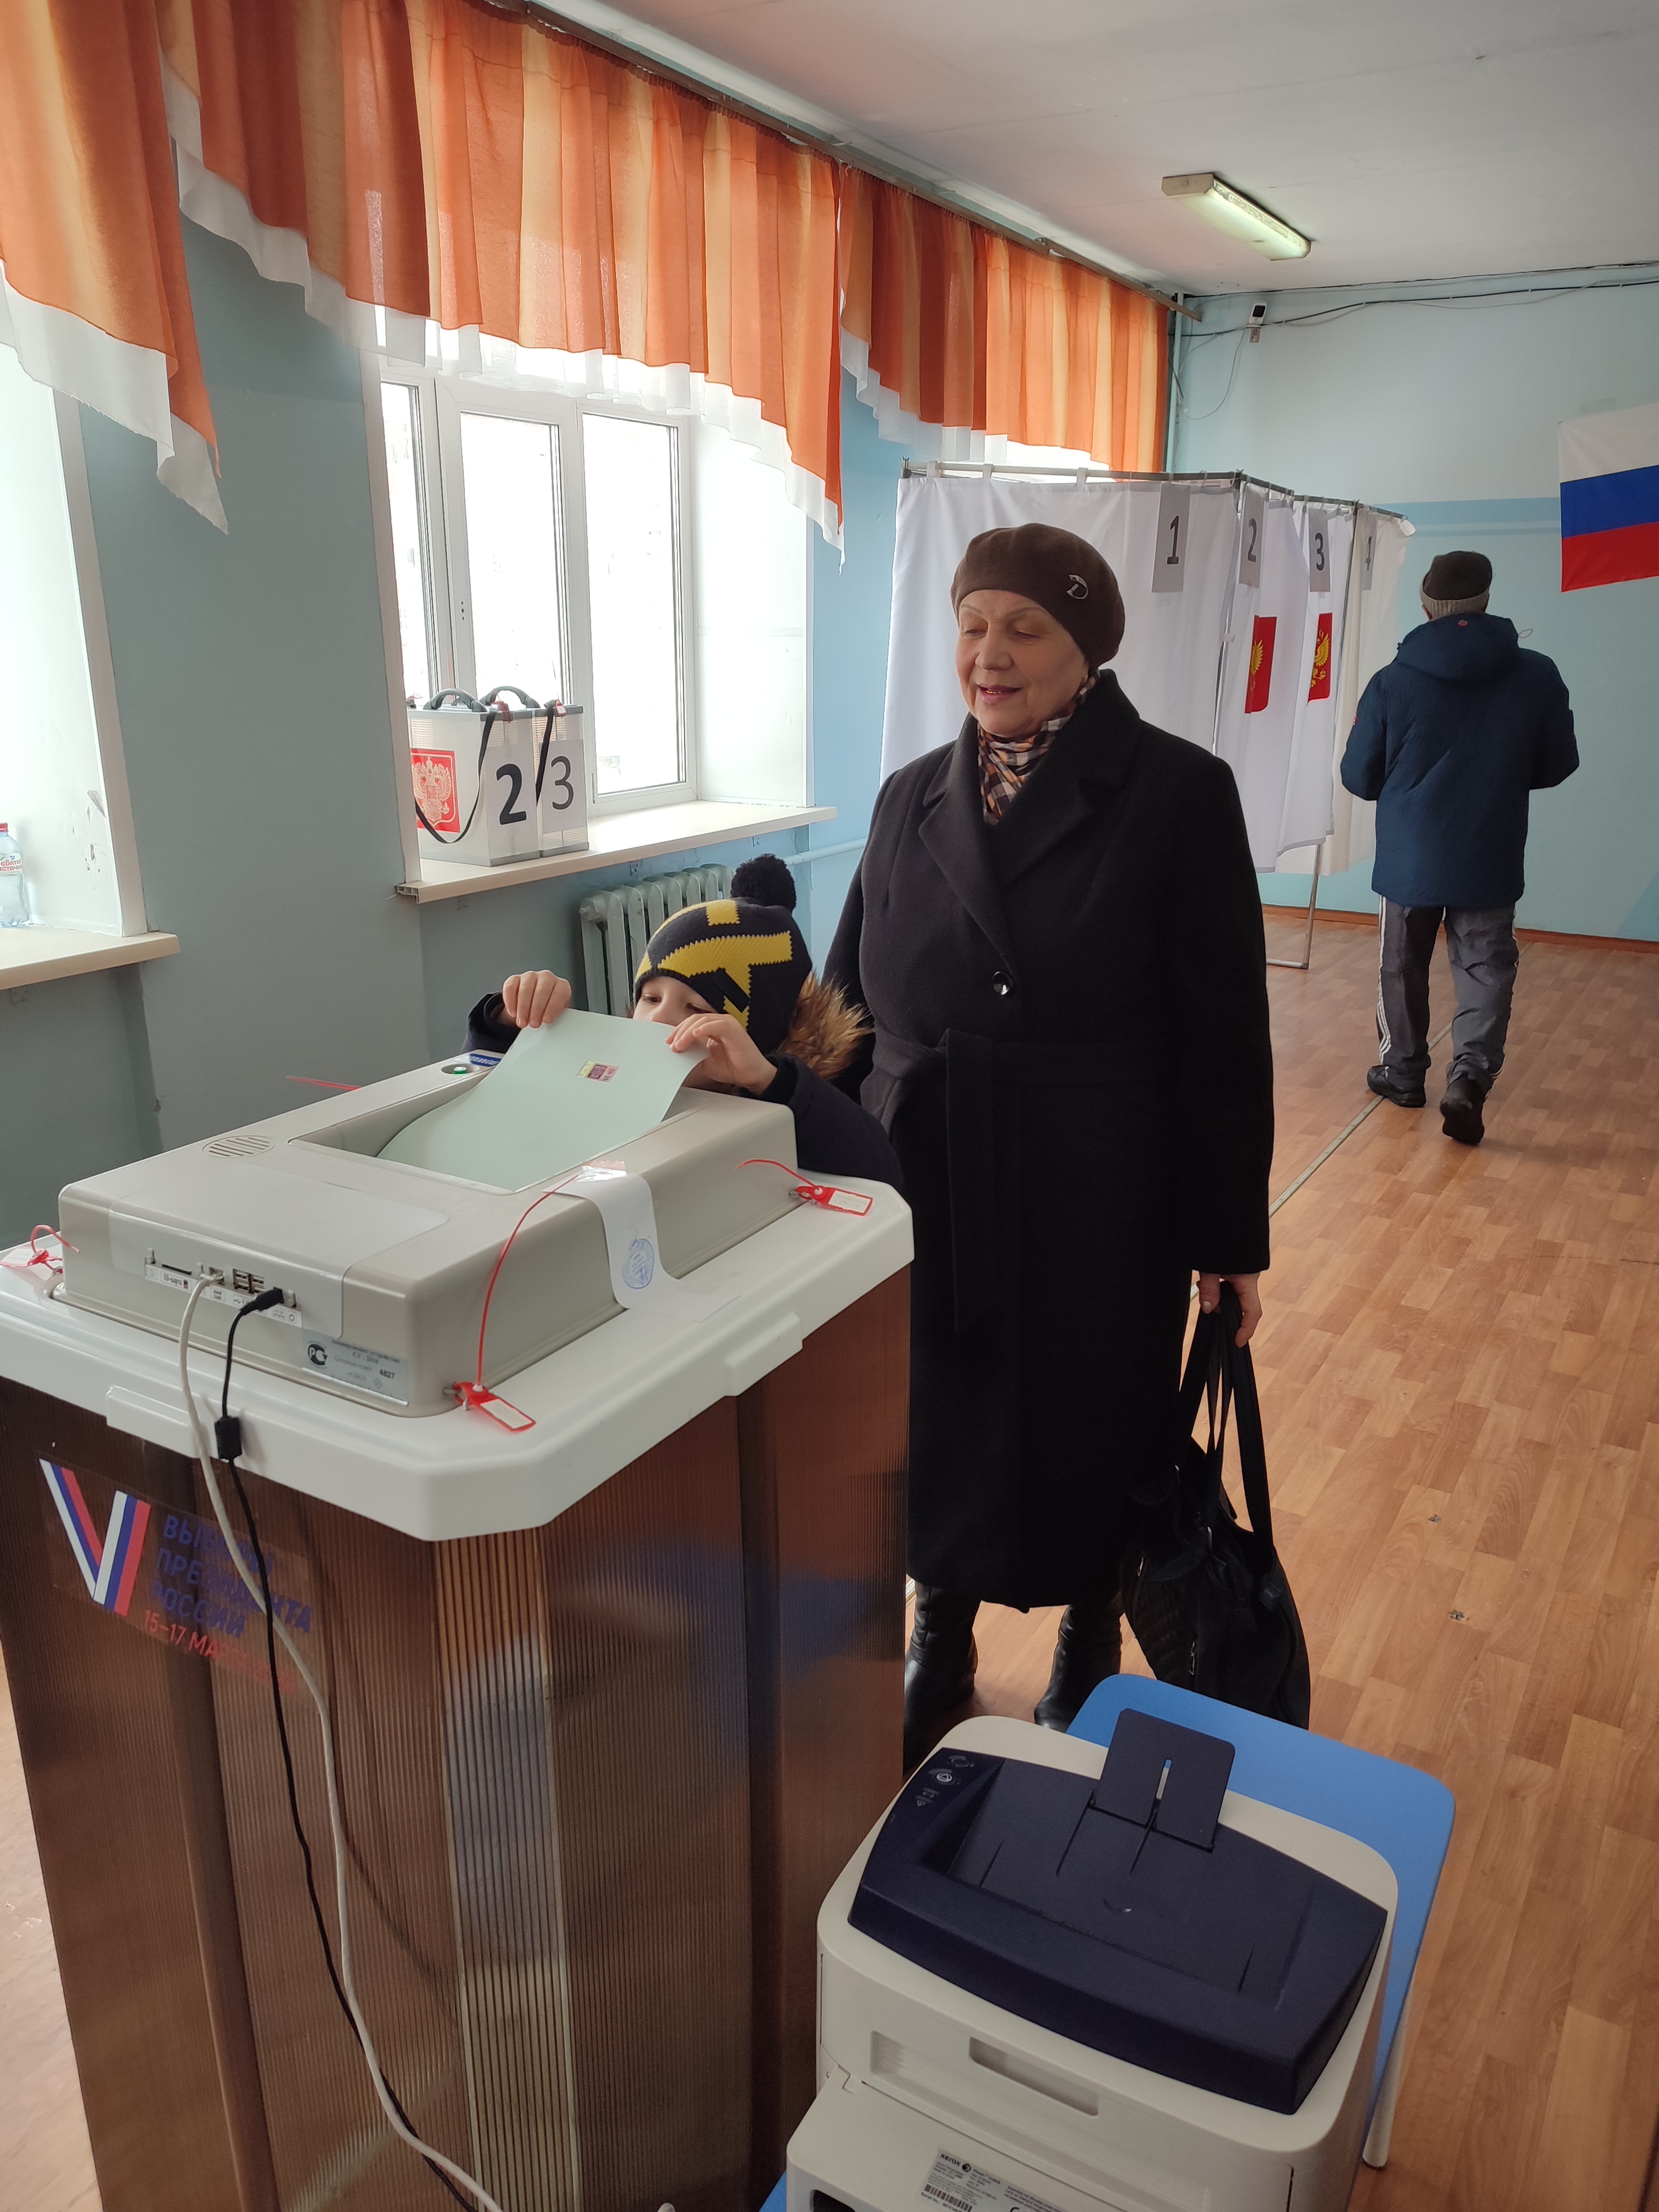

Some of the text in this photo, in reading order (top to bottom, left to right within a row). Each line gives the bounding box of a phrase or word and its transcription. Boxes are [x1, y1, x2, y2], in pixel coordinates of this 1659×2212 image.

[1166, 515, 1180, 565] 1
[1247, 518, 1257, 563] 2
[1314, 532, 1325, 571] 3
[495, 763, 527, 825] 2
[550, 755, 574, 810] 3
[379, 1369, 395, 1379] 4827
[940, 2153, 961, 2167] xerox
